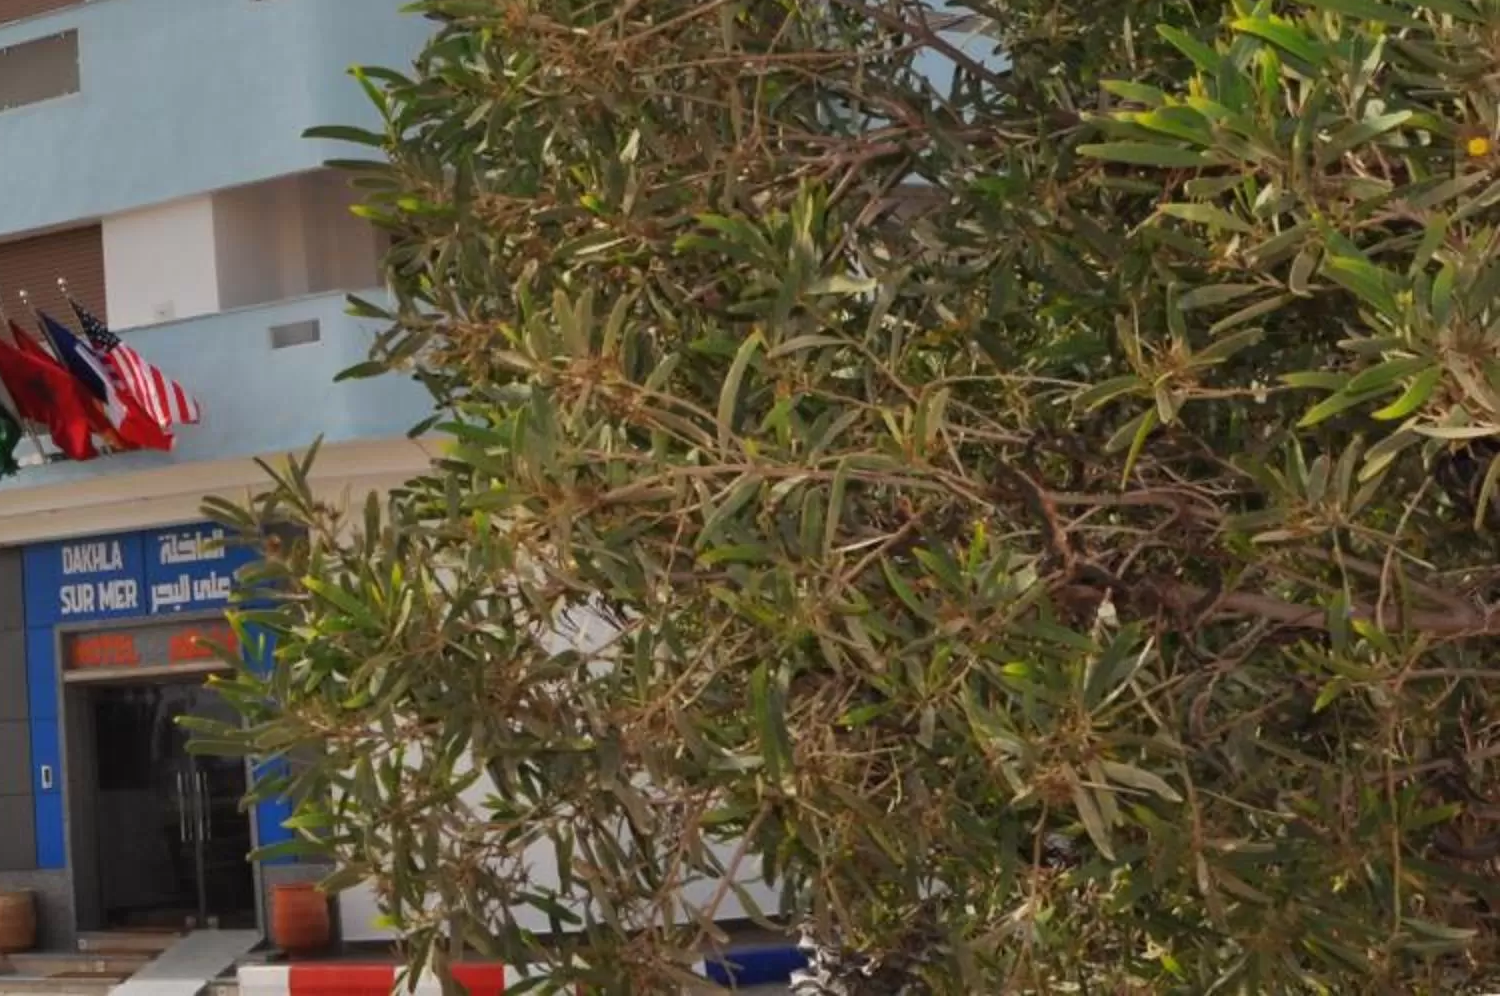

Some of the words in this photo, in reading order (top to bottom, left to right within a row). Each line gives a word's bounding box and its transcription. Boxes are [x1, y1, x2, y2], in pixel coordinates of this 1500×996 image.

[62, 540, 123, 575] DAKHLA
[60, 583, 95, 614] SUR
[99, 578, 138, 611] MER
[151, 573, 191, 613] البحر
